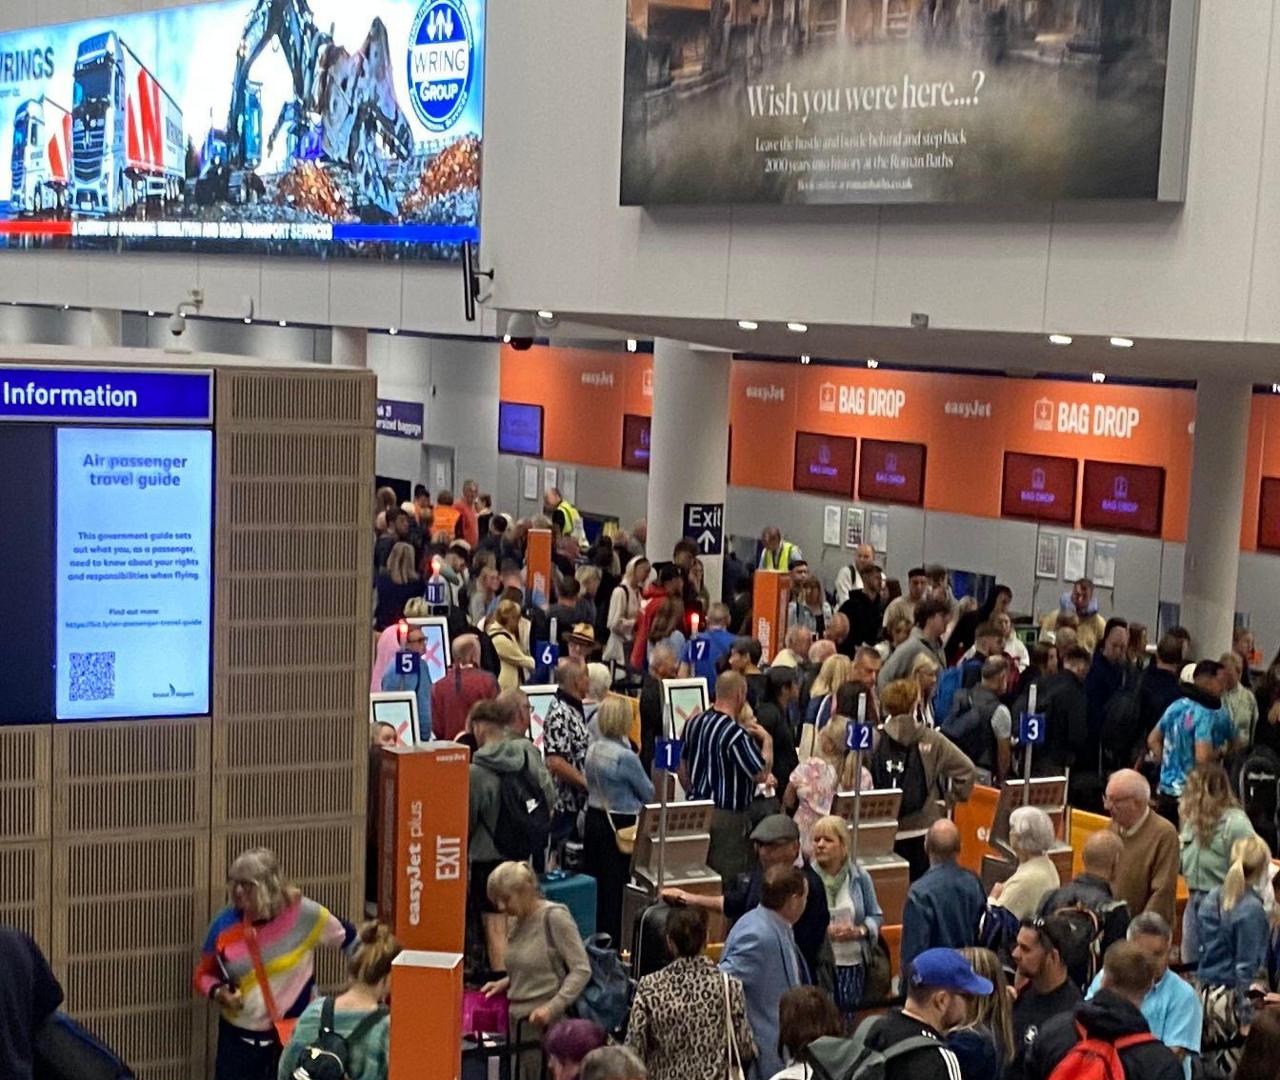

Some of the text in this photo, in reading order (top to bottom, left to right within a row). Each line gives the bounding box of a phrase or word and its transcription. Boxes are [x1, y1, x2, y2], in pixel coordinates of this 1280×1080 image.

[414, 49, 466, 73] WRING
[747, 69, 986, 124] Wish you were here...?
[944, 128, 967, 145] back
[3, 381, 137, 408] Information
[839, 386, 905, 418] BAG DROP
[1057, 402, 1140, 439] BAG DROP
[83, 453, 188, 472] Air passenger
[90, 472, 180, 489] travel guide
[78, 532, 96, 541] This
[98, 532, 148, 541] government
[150, 532, 173, 541] guide
[73, 546, 88, 554] out
[90, 545, 112, 554] what
[70, 558, 199, 568] need to know about your rights
[68, 572, 84, 581] and
[86, 571, 149, 581] responsibilities
[150, 571, 173, 579] when
[542, 646, 553, 665] 6
[696, 641, 706, 660] 7
[402, 654, 413, 673] 5
[860, 726, 869, 748] 2
[1027, 719, 1040, 741] 3
[666, 743, 673, 764] 1
[407, 801, 423, 925] easyJet plus
[436, 835, 461, 880] EXIT
